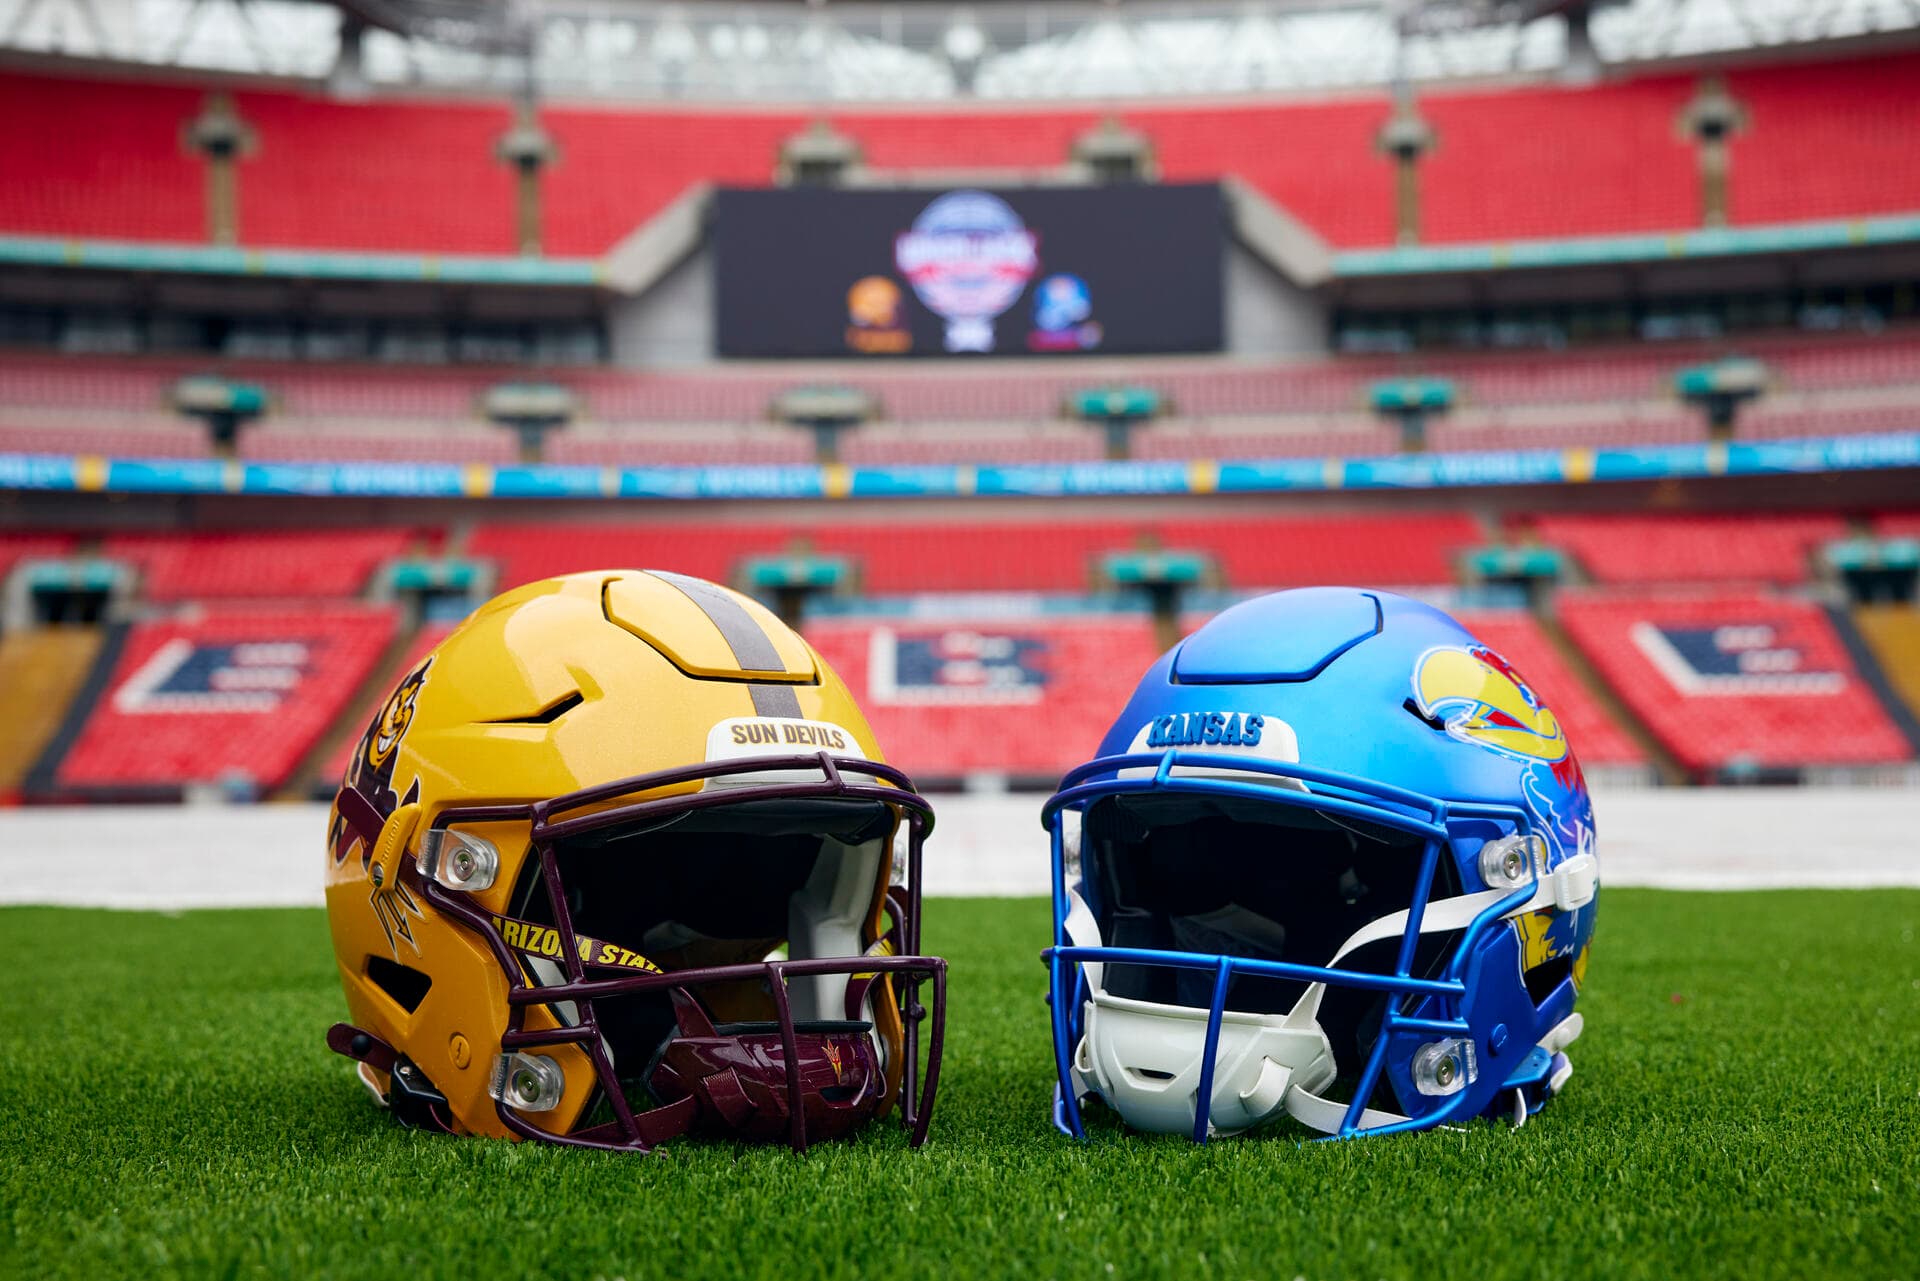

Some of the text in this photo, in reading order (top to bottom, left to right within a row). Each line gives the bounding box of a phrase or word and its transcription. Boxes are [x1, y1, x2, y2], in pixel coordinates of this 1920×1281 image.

[730, 723, 846, 750] SUN DEVILS
[1146, 712, 1265, 747] KANSAS
[492, 916, 664, 974] RIZOA STAT
